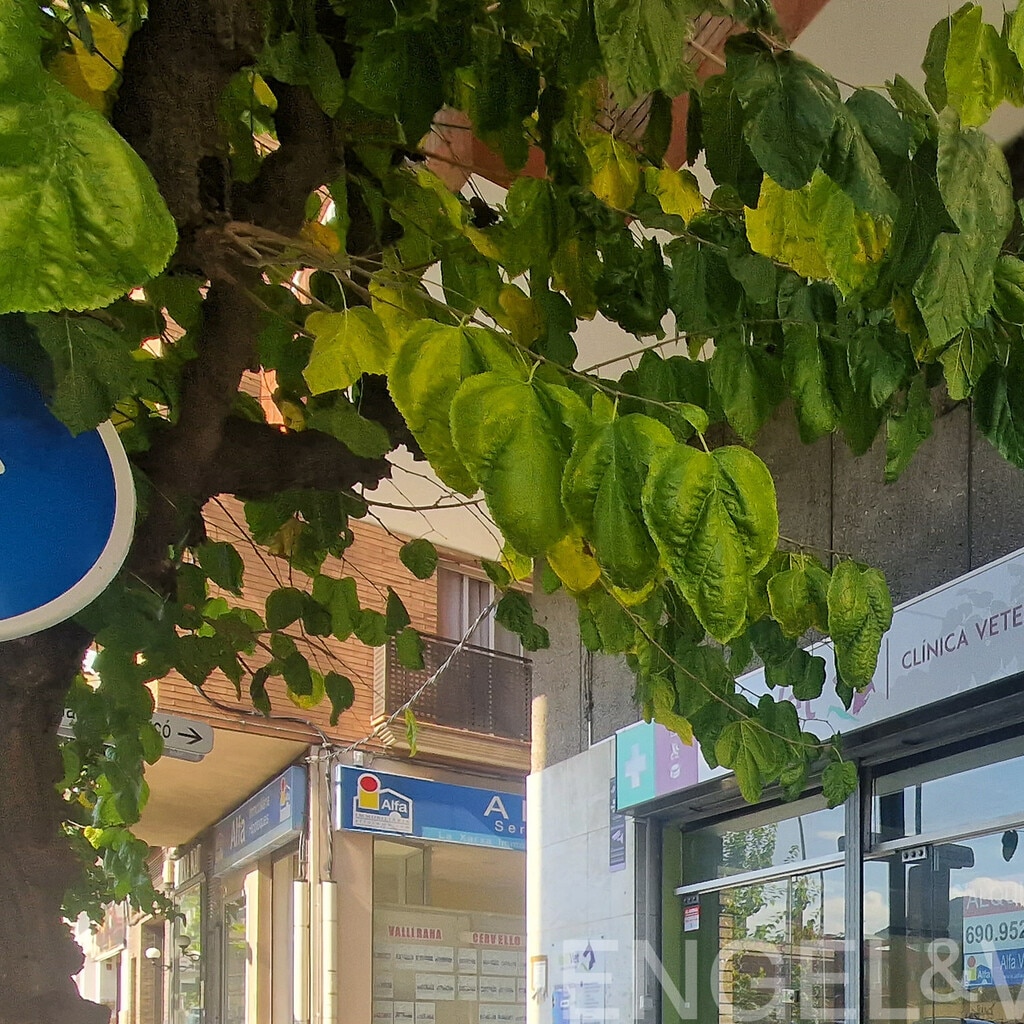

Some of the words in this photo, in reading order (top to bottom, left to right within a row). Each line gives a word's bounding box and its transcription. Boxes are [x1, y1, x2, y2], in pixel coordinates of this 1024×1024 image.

[901, 629, 969, 670] CLÍNICA
[381, 799, 408, 814] Alfa
[1000, 953, 1016, 970] Alfa
